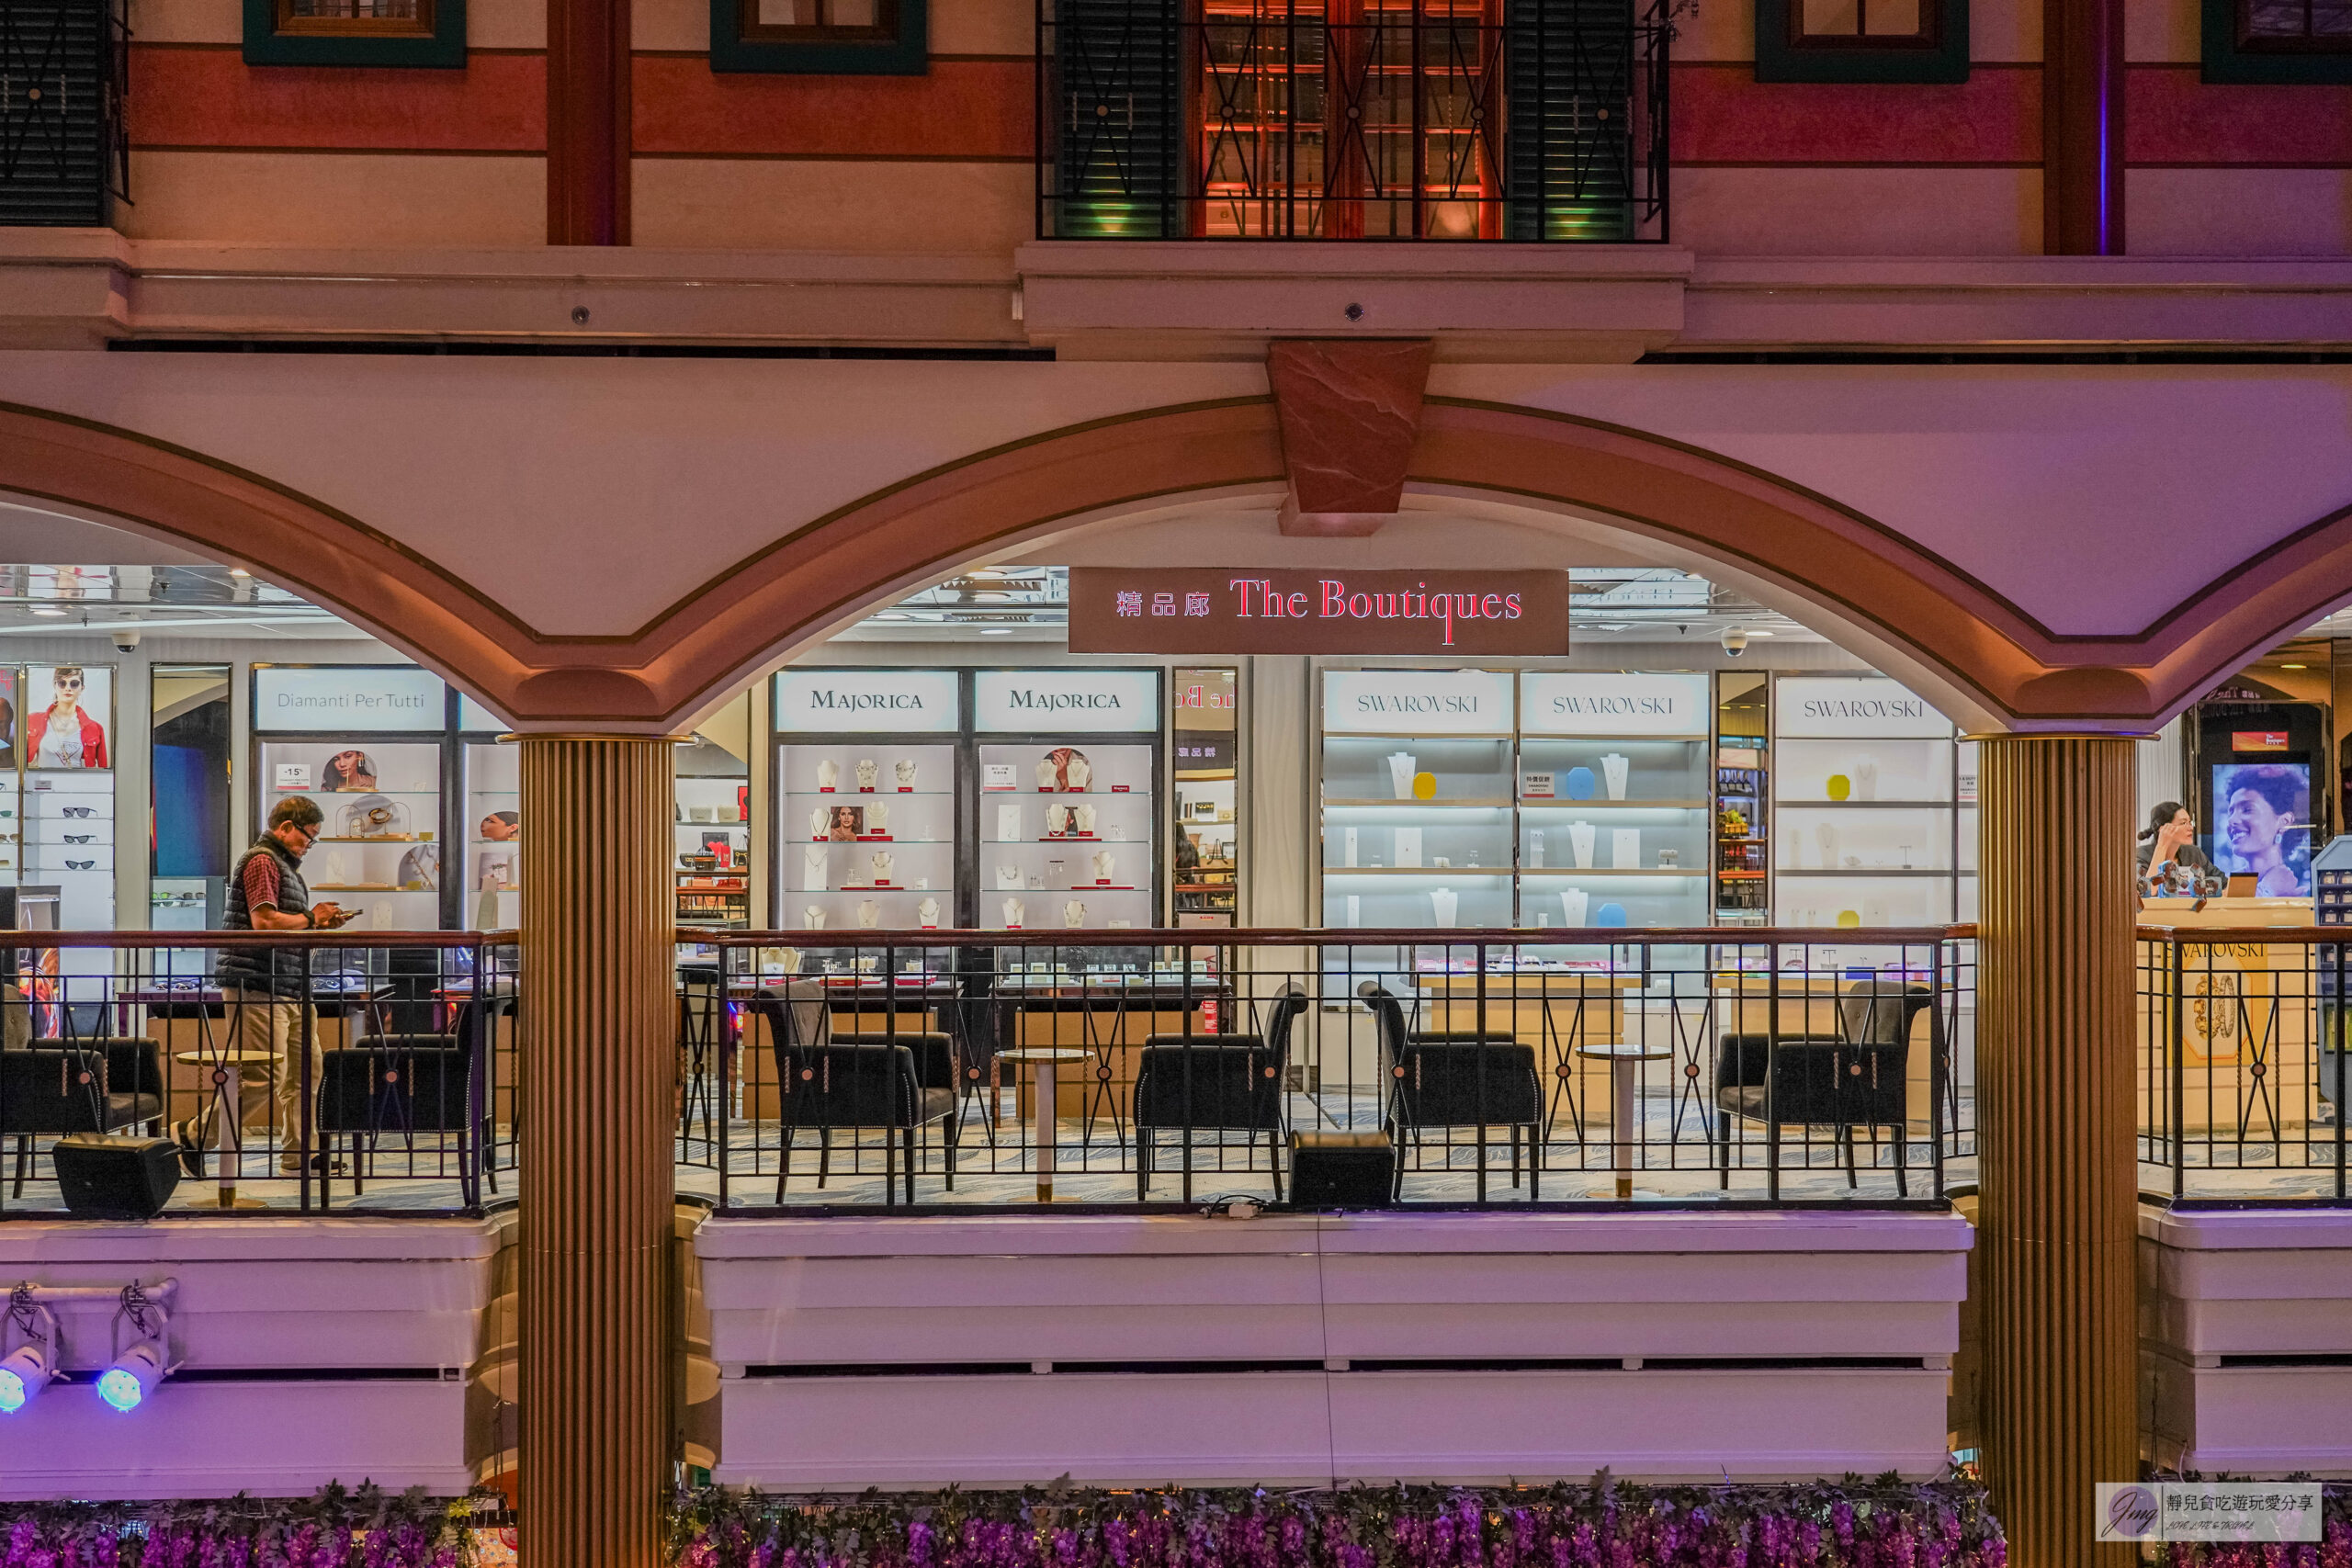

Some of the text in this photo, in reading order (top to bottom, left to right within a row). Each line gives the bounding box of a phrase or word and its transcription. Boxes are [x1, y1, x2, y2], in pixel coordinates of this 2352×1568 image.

[1115, 591, 1211, 618] 精品廊
[1229, 579, 1522, 646] The Boutiques
[277, 693, 424, 707] Diamanti Per Tutti
[809, 689, 924, 712] MAJORICA
[1008, 689, 1122, 712] MAJORICA
[1357, 694, 1478, 713] SWAROVSKI
[1553, 696, 1673, 715] SWAROVSKI
[1804, 700, 1923, 717] SWAROVSKI
